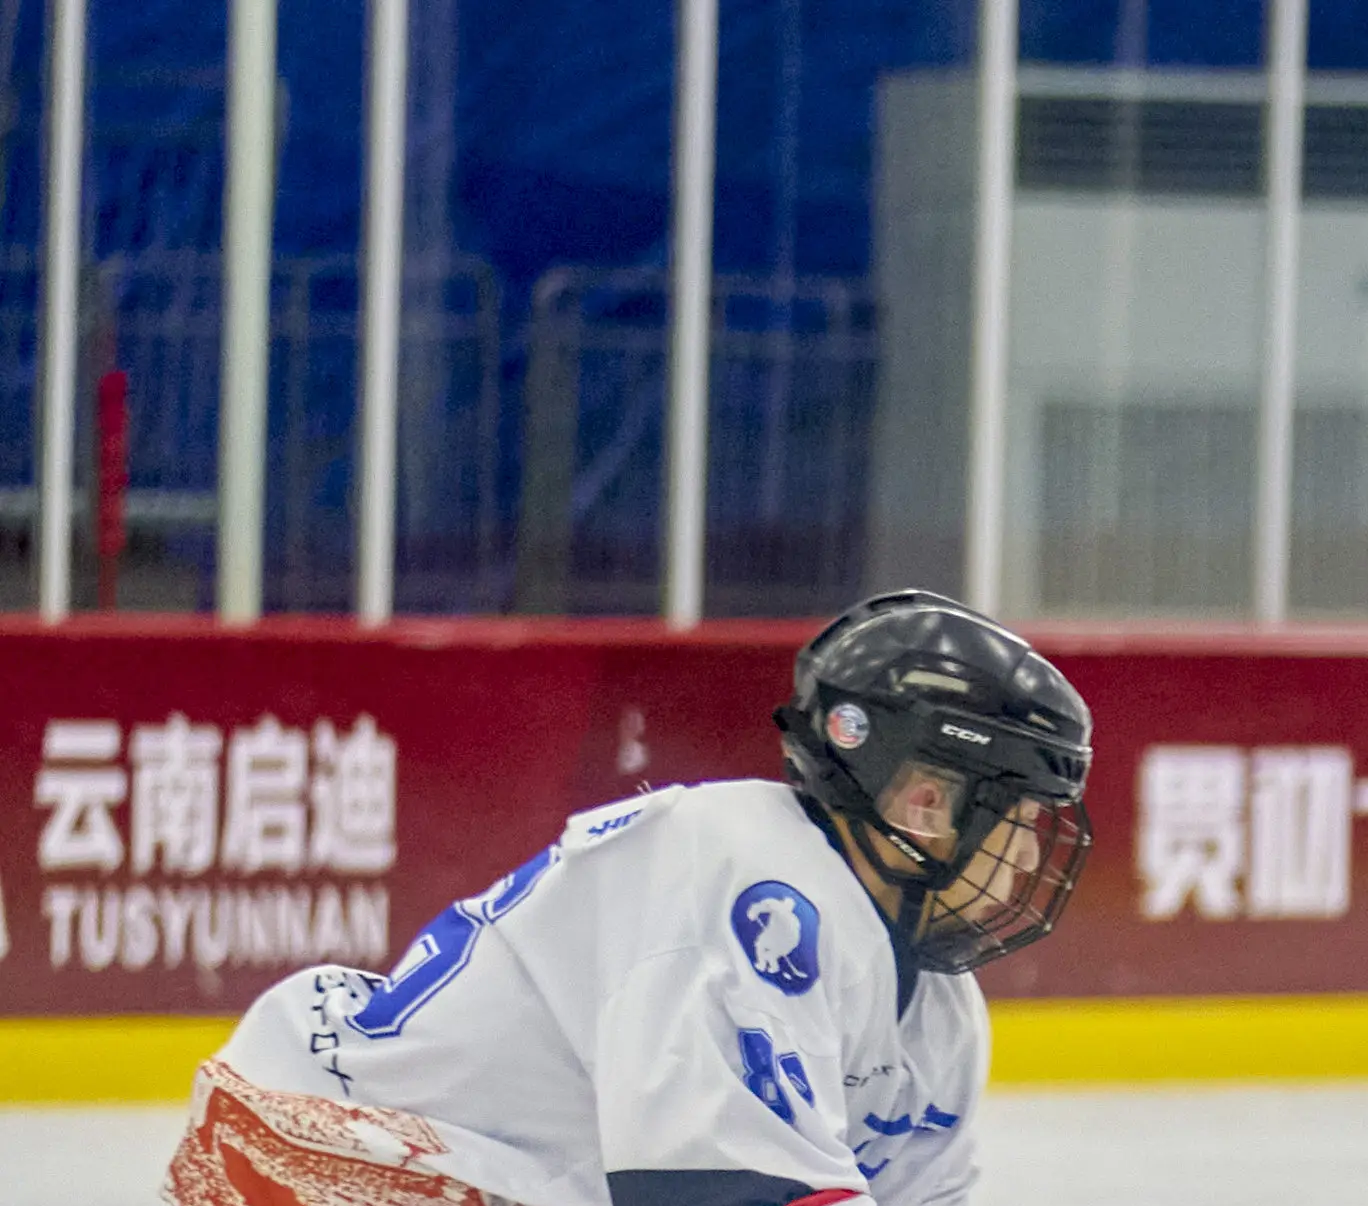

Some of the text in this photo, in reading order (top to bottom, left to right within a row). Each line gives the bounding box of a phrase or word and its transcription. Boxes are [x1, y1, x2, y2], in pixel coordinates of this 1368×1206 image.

[940, 723, 992, 745] CCM
[35, 710, 397, 877] 云南启迪
[43, 885, 390, 970] TUSYUNNAN
